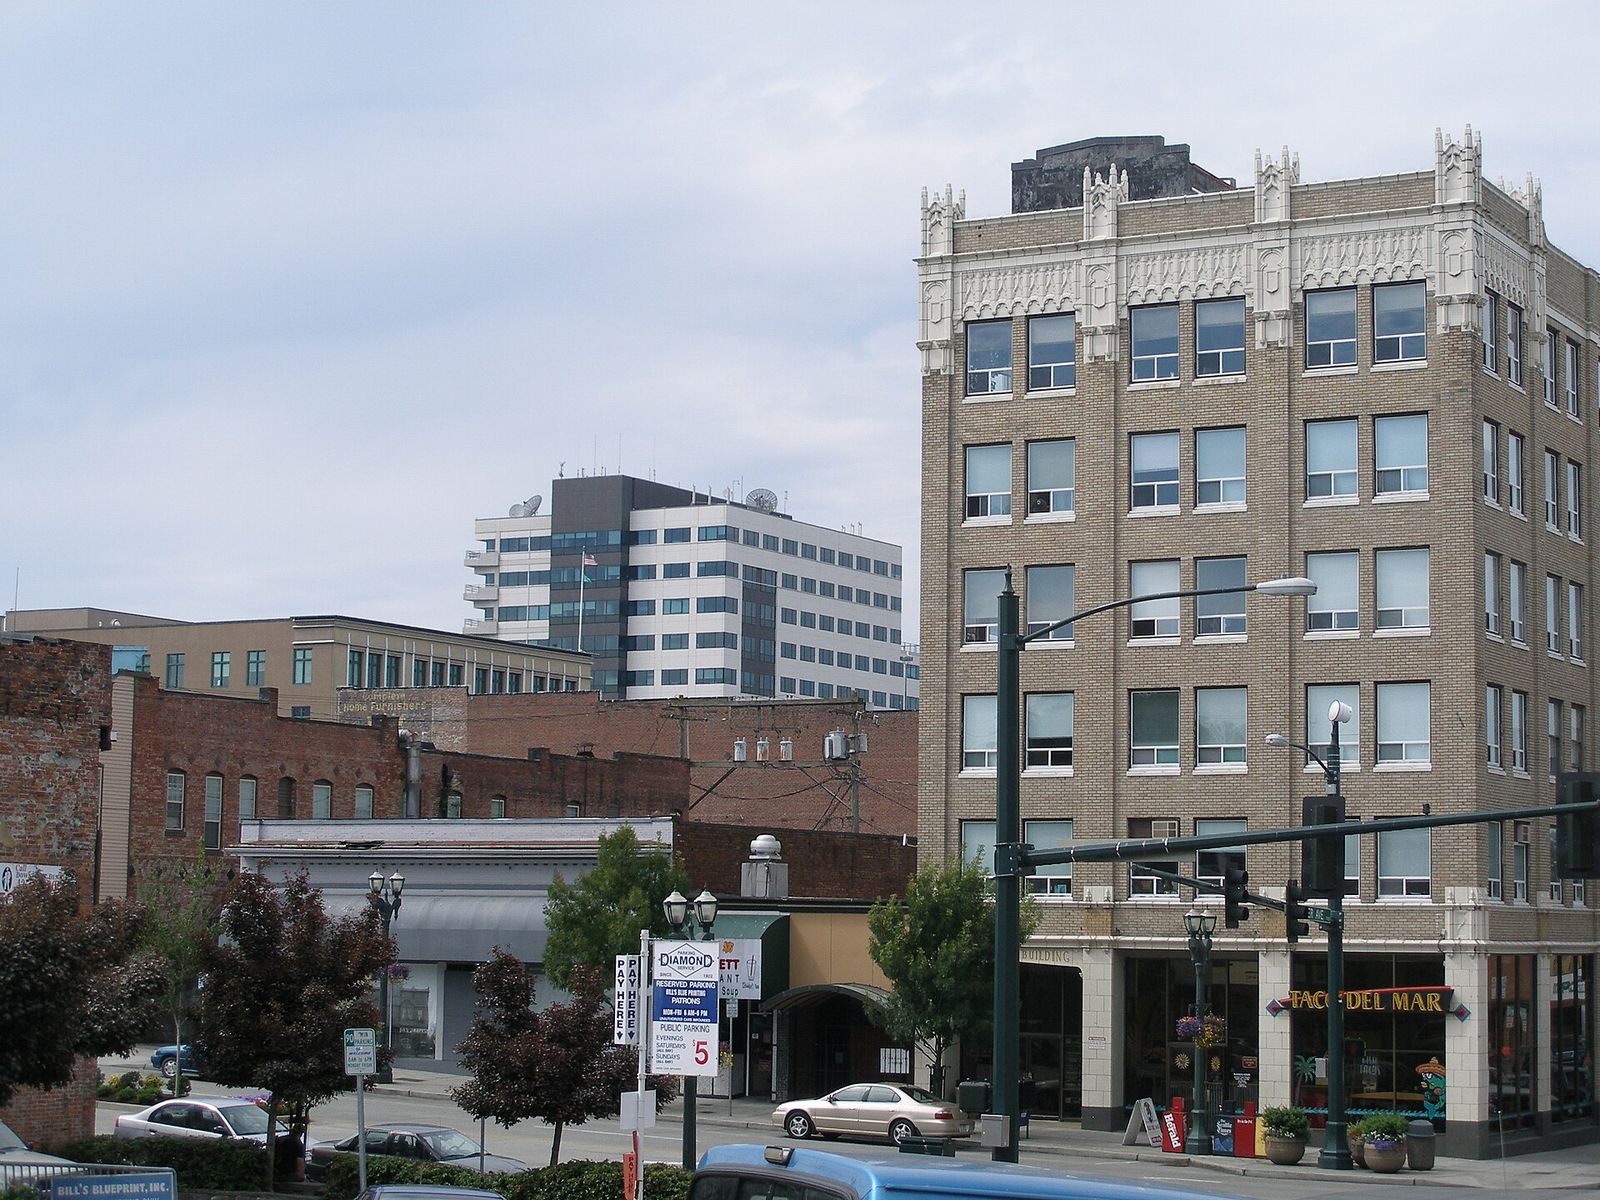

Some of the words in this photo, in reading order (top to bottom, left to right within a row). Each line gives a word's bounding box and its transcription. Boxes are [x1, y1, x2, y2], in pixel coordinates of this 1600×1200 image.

[343, 703, 367, 712] Home
[660, 953, 713, 968] DIAMOND
[1022, 950, 1070, 963] BUILDING
[617, 960, 625, 988] PAY
[628, 959, 637, 988] PAY
[656, 980, 688, 988] RESERVED
[689, 981, 717, 989] PARKING
[721, 986, 739, 997] Soup
[671, 997, 701, 1005] PATRONS
[1289, 990, 1329, 1009] TAC
[1346, 991, 1385, 1010] DEL
[1392, 992, 1443, 1012] MAR
[616, 991, 625, 1029] HERE
[627, 990, 637, 1029] HERE
[660, 1023, 682, 1032] PUBLIC
[683, 1024, 710, 1033] PARKING
[695, 1040, 709, 1065] 5
[1163, 1113, 1181, 1149] Herald
[1216, 1120, 1233, 1129] Seattle
[58, 1183, 89, 1196] BILL'S
[92, 1182, 148, 1195] BLUEPRINT,
[149, 1182, 169, 1193] INC.
